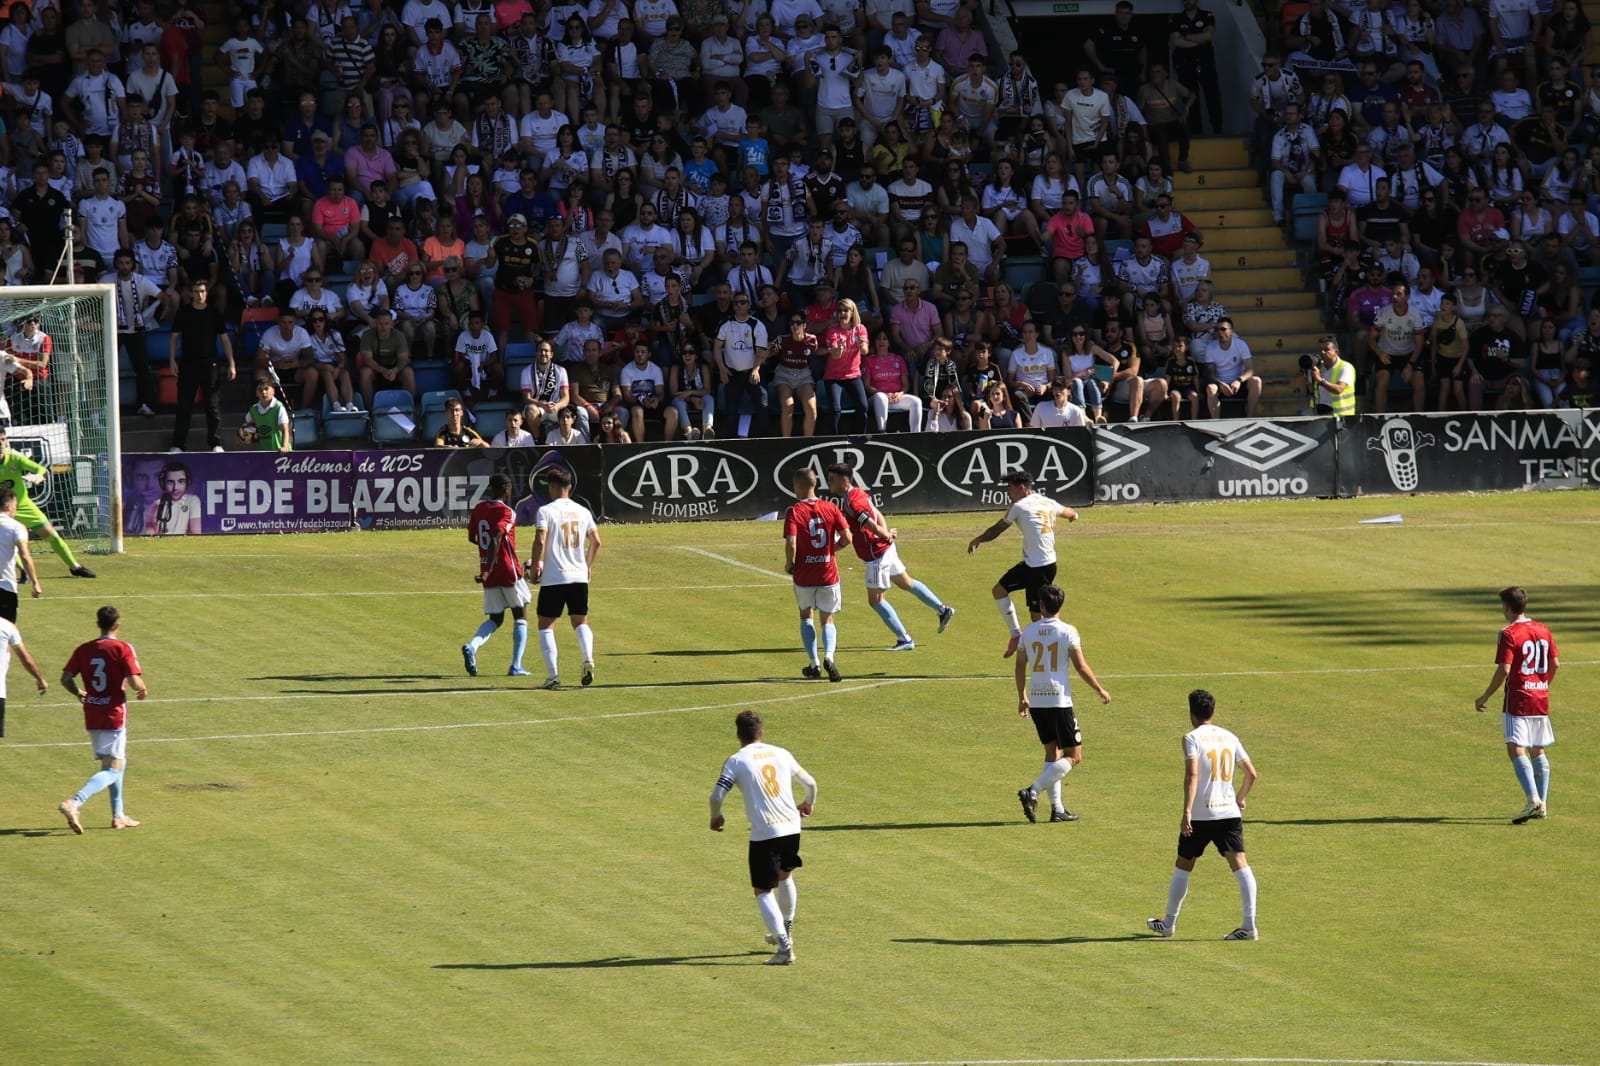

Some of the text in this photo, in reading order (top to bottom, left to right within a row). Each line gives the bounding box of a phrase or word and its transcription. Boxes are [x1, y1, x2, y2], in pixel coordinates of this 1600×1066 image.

[1198, 175, 1205, 185] 8
[1218, 215, 1225, 226] 7
[1238, 256, 1246, 267] 6
[275, 454, 424, 473] Hablemos de UDS
[631, 454, 740, 499] ARA
[807, 447, 905, 491] ARA
[961, 441, 1069, 487] ARA
[206, 475, 490, 515] FEDE BLAZQUEZ
[981, 487, 1046, 505] HOME
[1218, 474, 1308, 497] umbro
[652, 499, 719, 518] HOMBRE
[237, 518, 350, 533] www.twitch.tv/fedeblazque
[479, 519, 491, 550] 6
[561, 521, 580, 548] 15
[809, 517, 827, 549] 5
[1031, 641, 1059, 672] 21
[1521, 639, 1549, 675] 20
[90, 657, 107, 692] 3
[761, 764, 780, 797] 8
[1206, 748, 1233, 782] 10
